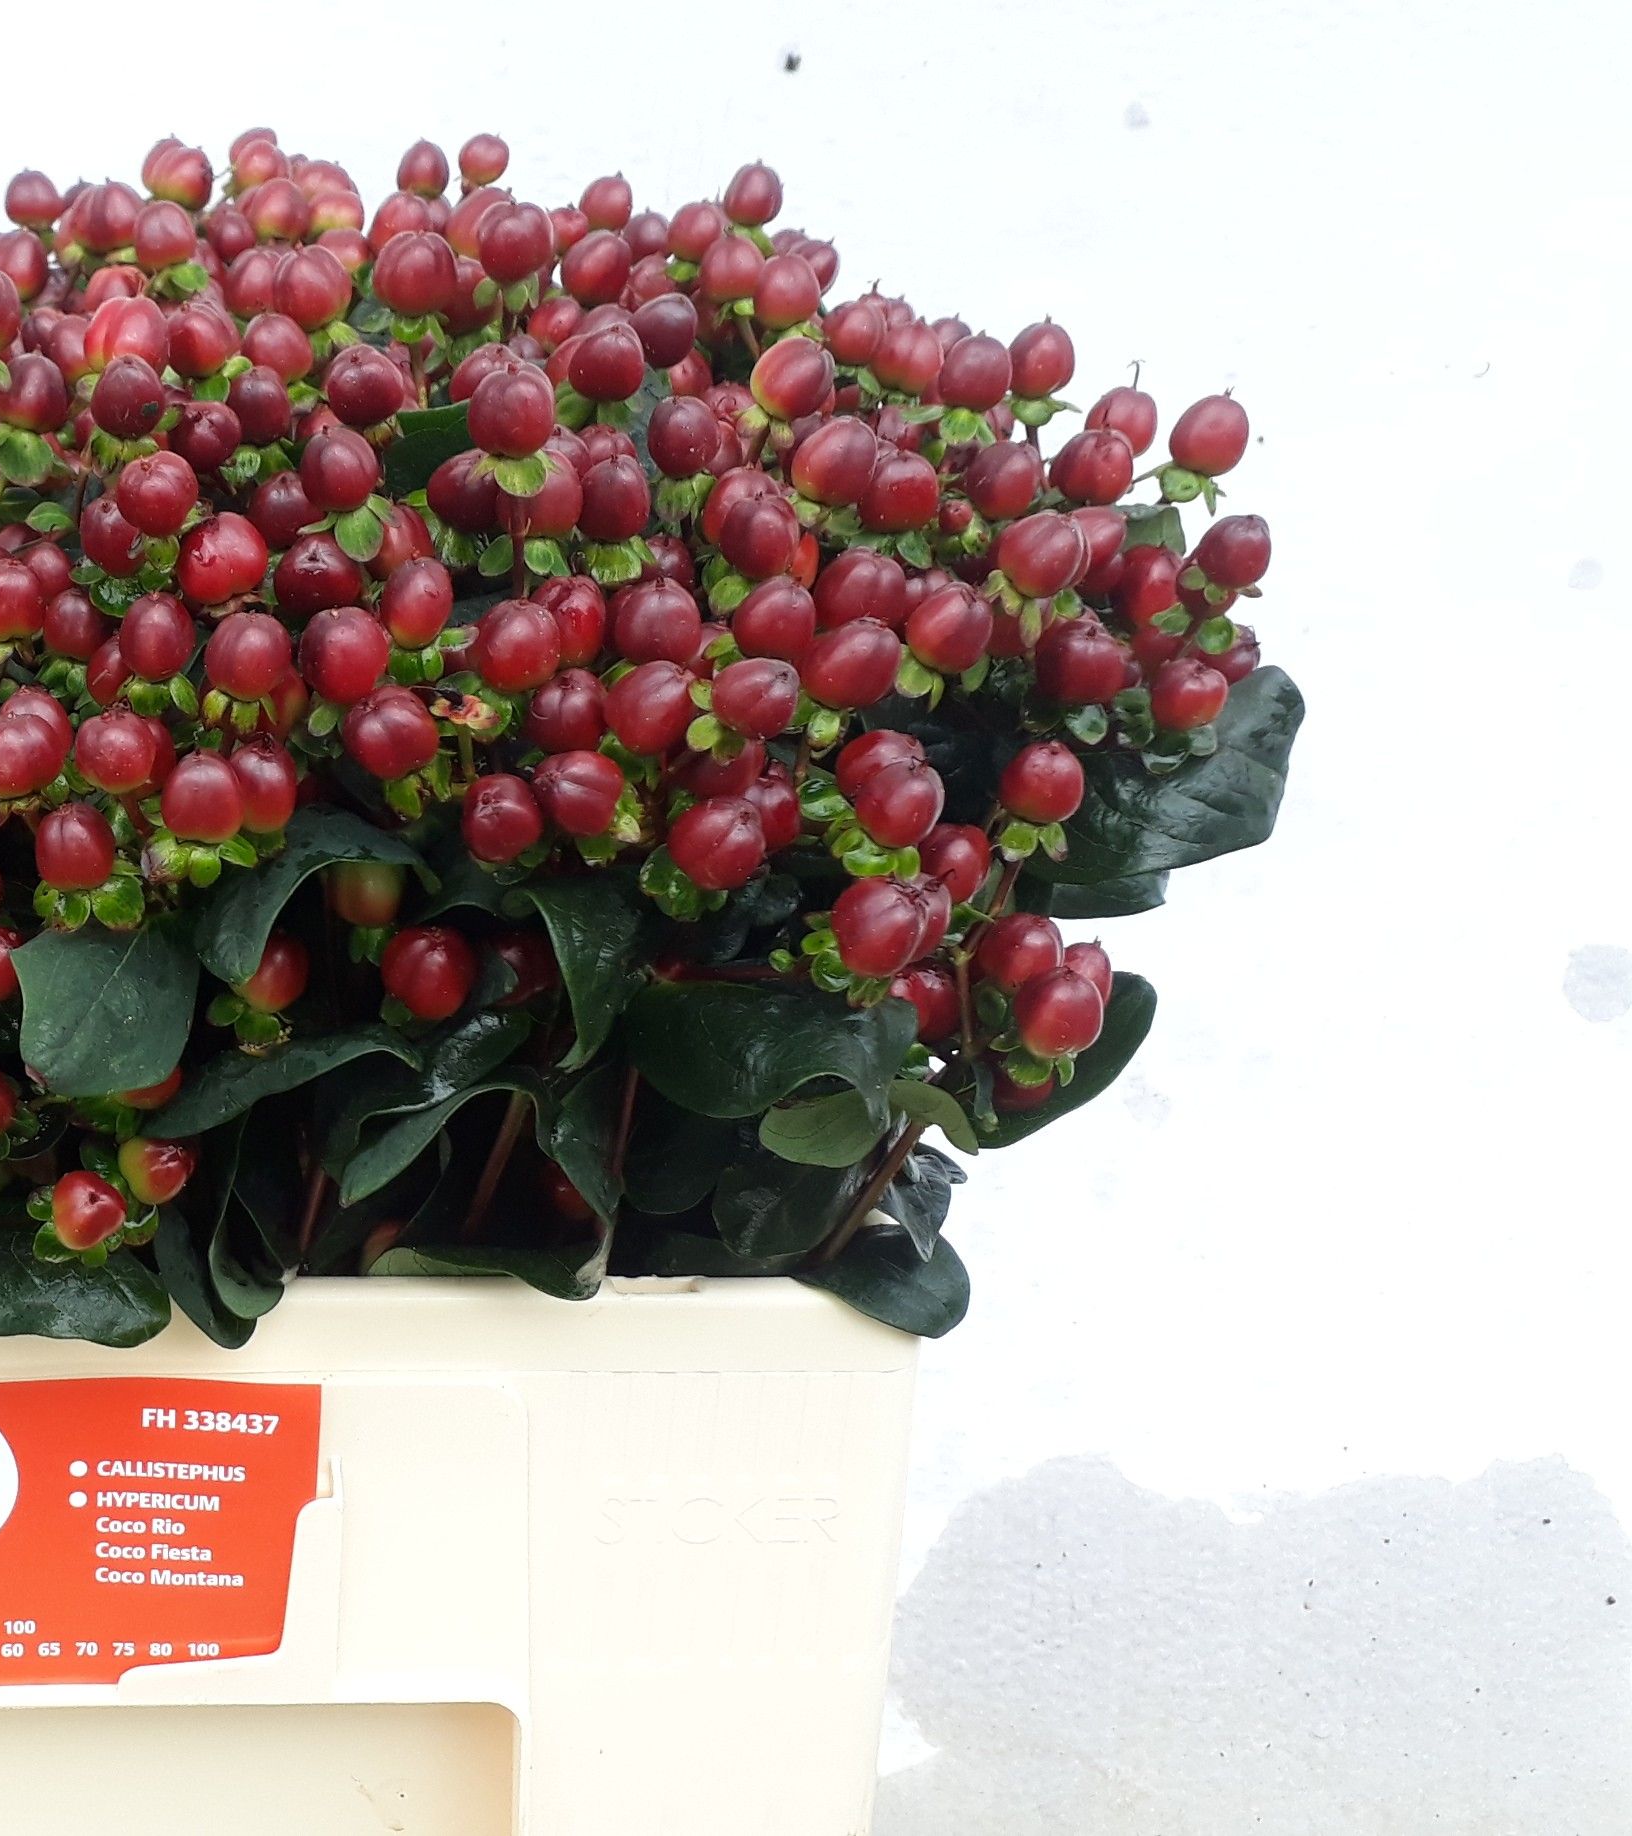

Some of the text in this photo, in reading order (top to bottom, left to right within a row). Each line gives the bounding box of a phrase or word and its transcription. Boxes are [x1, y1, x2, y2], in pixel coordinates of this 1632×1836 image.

[142, 1407, 280, 1435] FH 338437
[96, 1460, 246, 1482] CALLISTEPHUS
[96, 1491, 220, 1512] HYPERICUM
[95, 1516, 186, 1536] Coco Rio
[95, 1541, 212, 1562] Coco Fiesta
[94, 1566, 244, 1587] Coco Montana
[3, 1619, 36, 1635] 100
[0, 1642, 25, 1658] 60
[37, 1642, 61, 1657] 65
[74, 1641, 99, 1657] 70
[112, 1642, 136, 1657] 75
[149, 1642, 173, 1657] 80
[186, 1642, 221, 1657] 100
